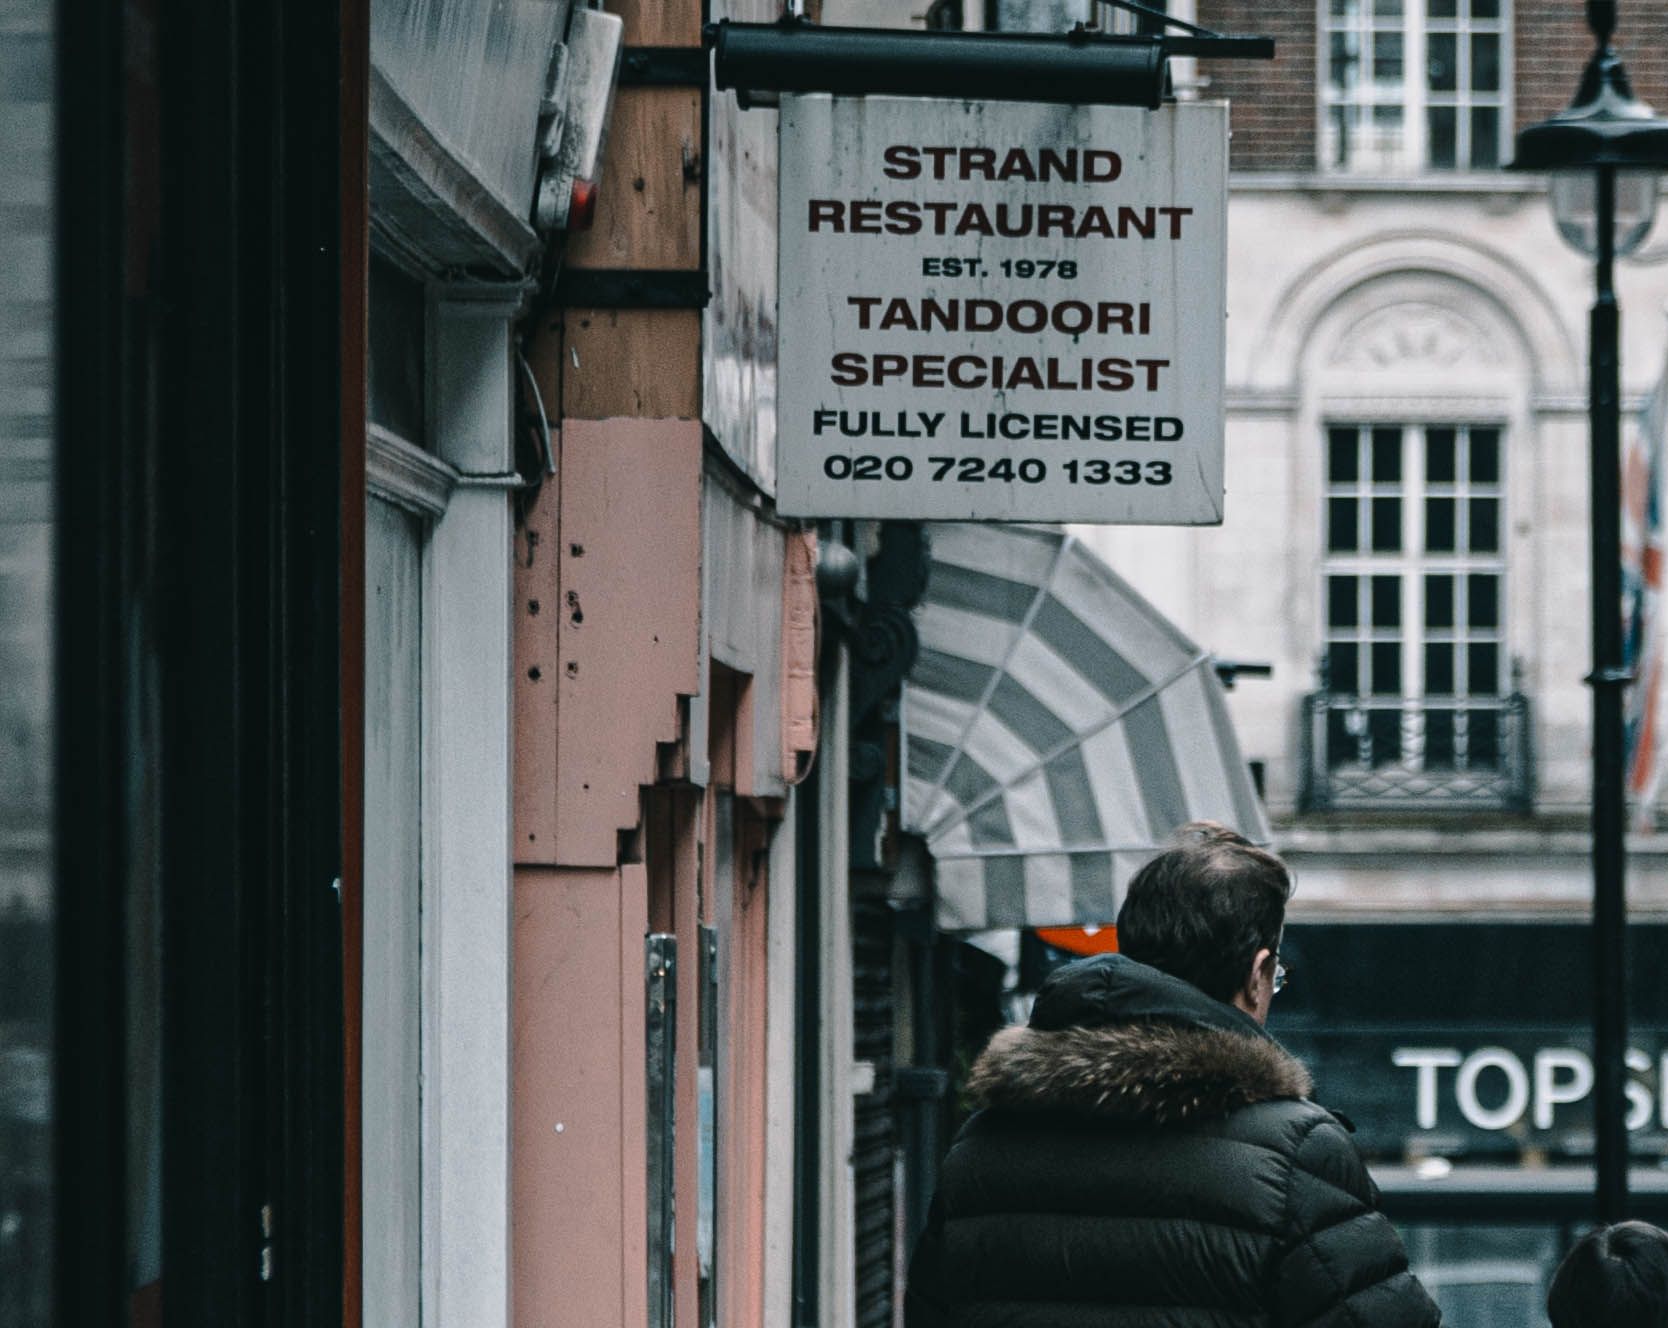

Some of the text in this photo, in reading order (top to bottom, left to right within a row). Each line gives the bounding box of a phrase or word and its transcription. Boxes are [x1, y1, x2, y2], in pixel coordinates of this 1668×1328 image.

[883, 146, 1122, 183] STRAND
[807, 199, 1193, 240] RESTAURANT
[922, 257, 1078, 279] EST. 1978
[847, 297, 1150, 334] TANDOORI
[830, 353, 1169, 391] SPECIALIST
[813, 411, 1184, 441] FULLY LICENSED
[823, 456, 1173, 485] 020 7240 1333
